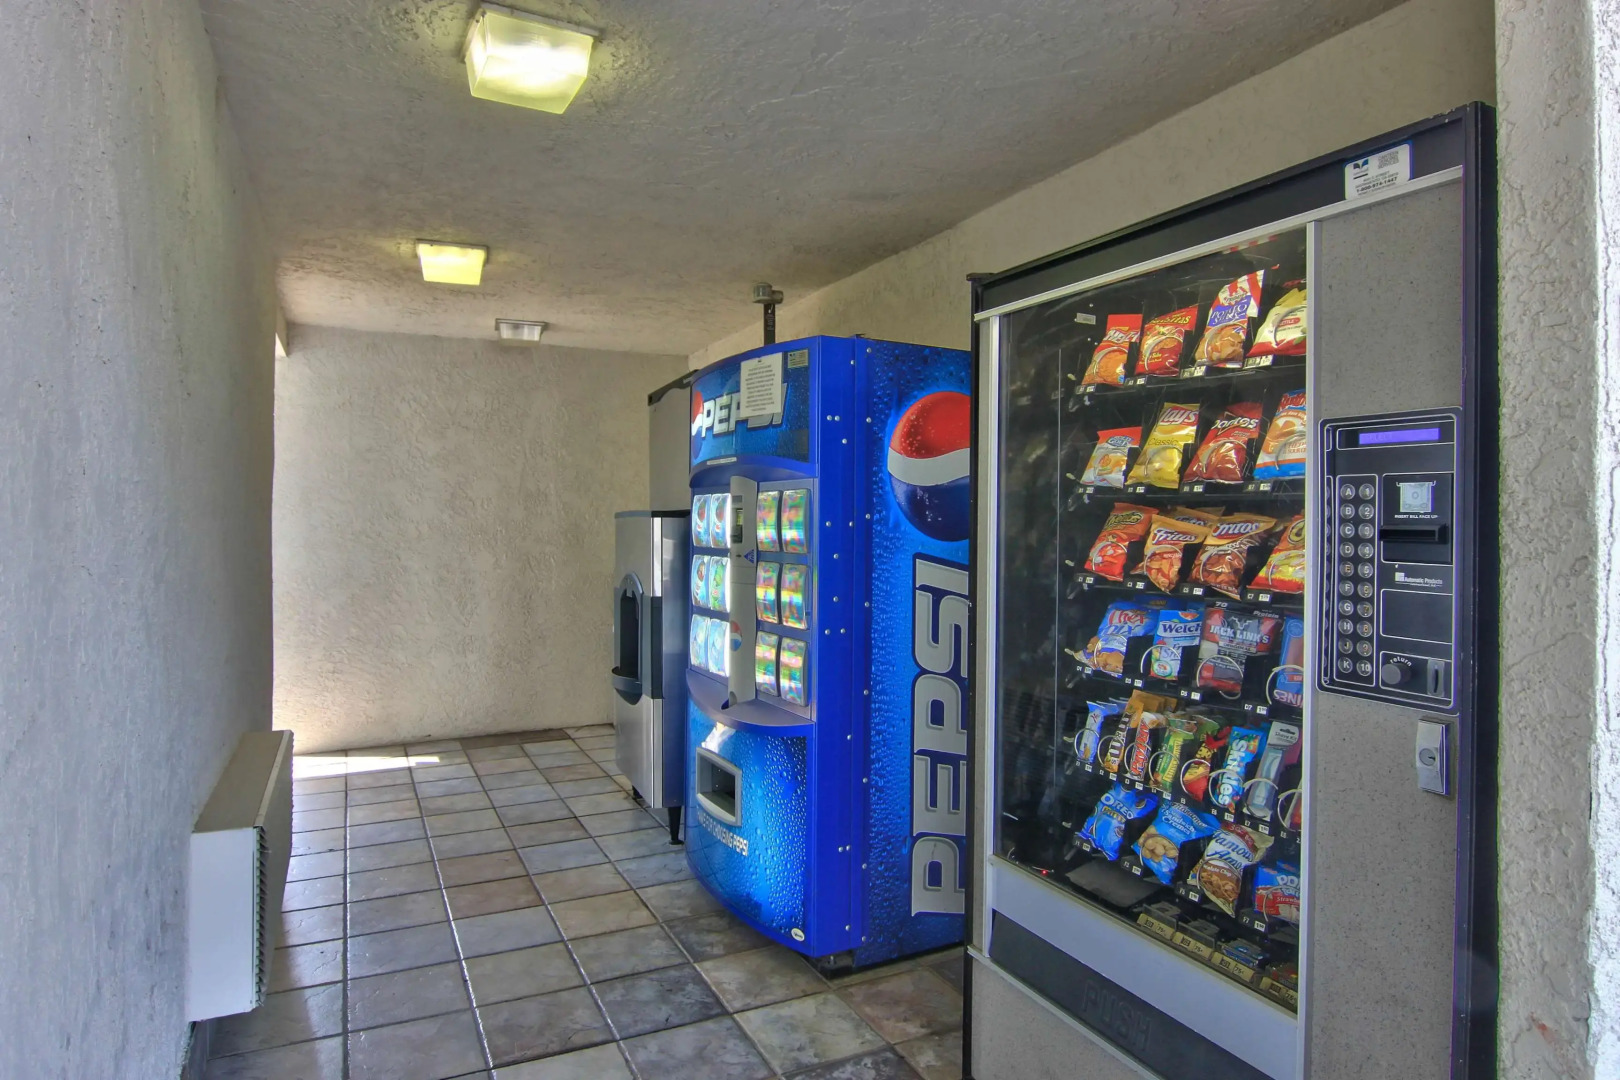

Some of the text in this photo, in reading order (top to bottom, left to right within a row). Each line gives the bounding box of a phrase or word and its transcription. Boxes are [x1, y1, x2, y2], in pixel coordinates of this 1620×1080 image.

[1152, 527, 1197, 544] Fritos
[1389, 656, 1413, 667] return
[911, 558, 969, 917] PEPSI
[1101, 793, 1134, 819] OREO
